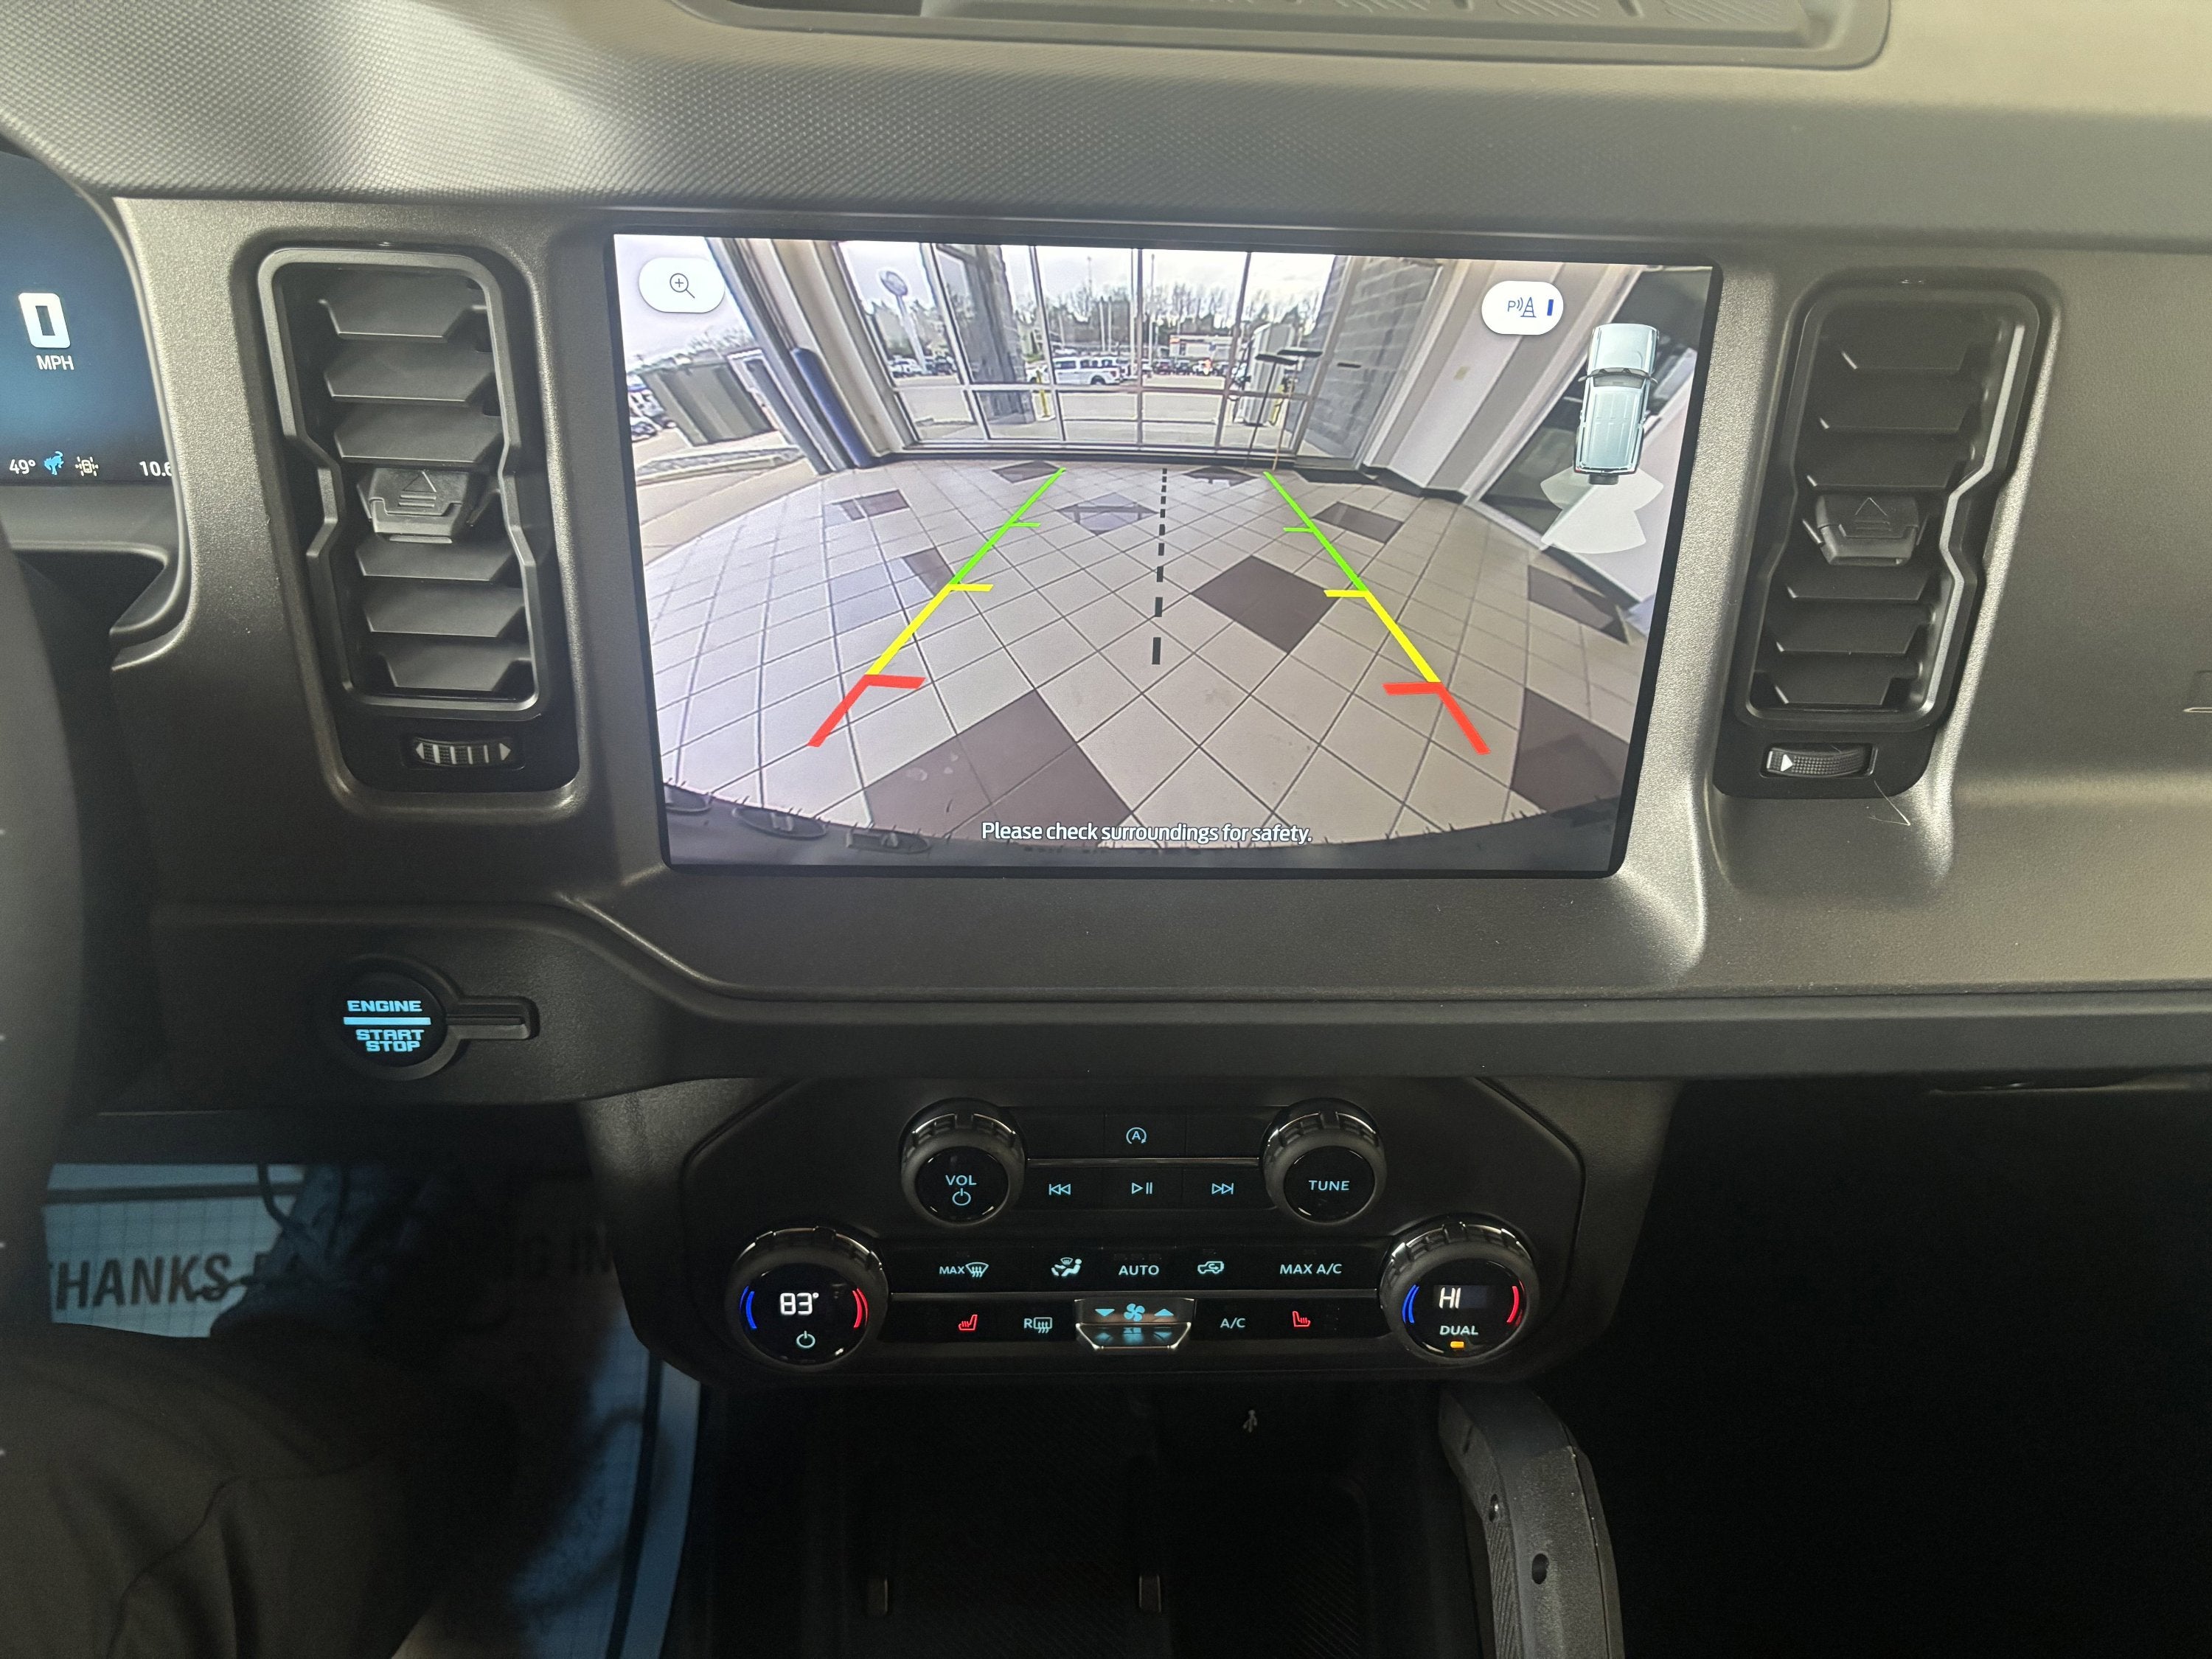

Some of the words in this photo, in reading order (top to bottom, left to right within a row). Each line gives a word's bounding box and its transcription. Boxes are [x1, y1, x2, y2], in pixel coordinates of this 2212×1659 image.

[18, 292, 72, 349] 0
[37, 355, 74, 370] MPH
[9, 459, 36, 475] 49°
[981, 821, 1043, 841] Please
[1046, 822, 1097, 841] check
[1101, 824, 1218, 844] surroundings
[1221, 825, 1249, 842] for
[1251, 824, 1312, 846] safety.
[347, 1000, 422, 1012] ENGINE
[355, 1029, 425, 1041] START
[366, 1040, 420, 1053] STOP
[945, 1175, 977, 1186] VOL
[1308, 1180, 1350, 1192] TUNE
[939, 1265, 964, 1276] MAX
[1118, 1265, 1160, 1276] AUTO
[1279, 1263, 1313, 1275] MAX
[1316, 1262, 1343, 1276] A/C
[49, 1252, 232, 1311] HANKS
[1439, 1287, 1461, 1309] HI
[1220, 1317, 1246, 1329] A/C
[1439, 1325, 1479, 1336] DUAL
